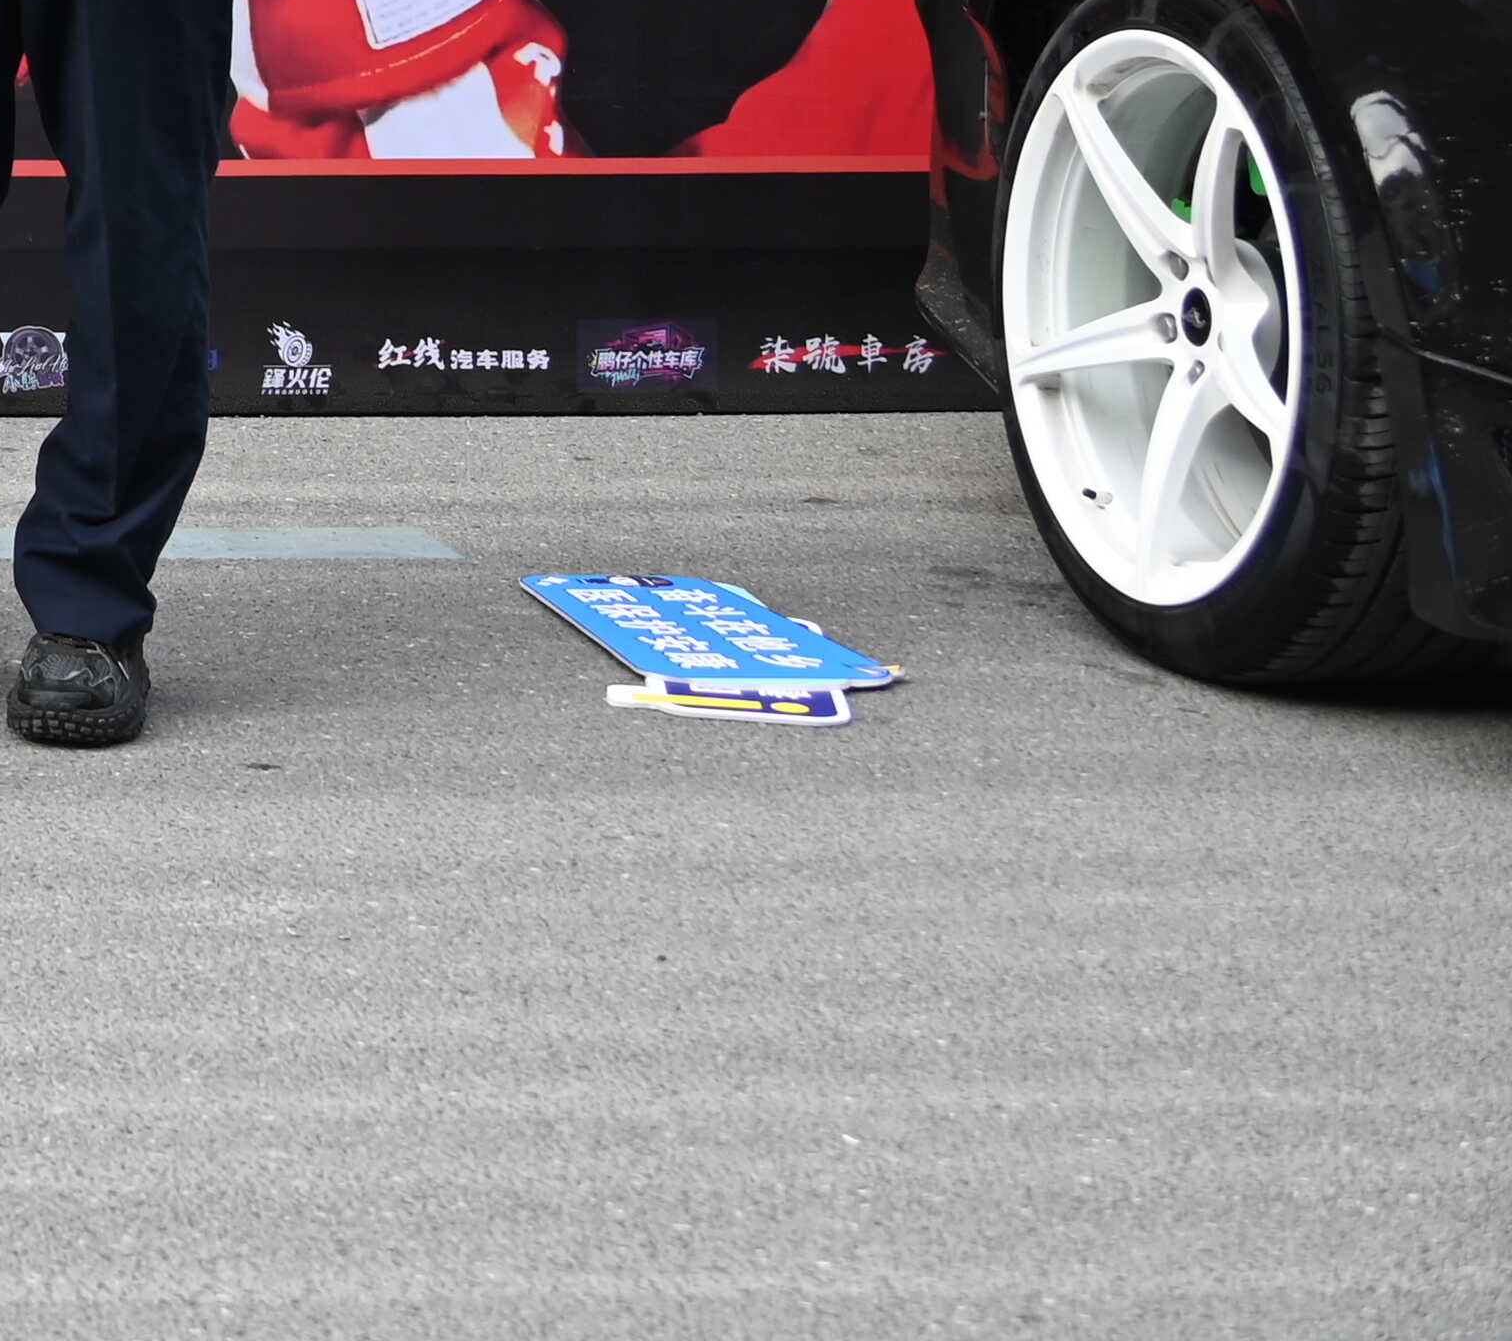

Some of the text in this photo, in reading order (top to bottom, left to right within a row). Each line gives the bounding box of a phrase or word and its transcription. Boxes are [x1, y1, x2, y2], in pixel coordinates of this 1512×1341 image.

[377, 338, 551, 370] 红线 汽车服务
[564, 588, 740, 672] 医保护安康
[650, 588, 825, 670] 奋斗在他乡
